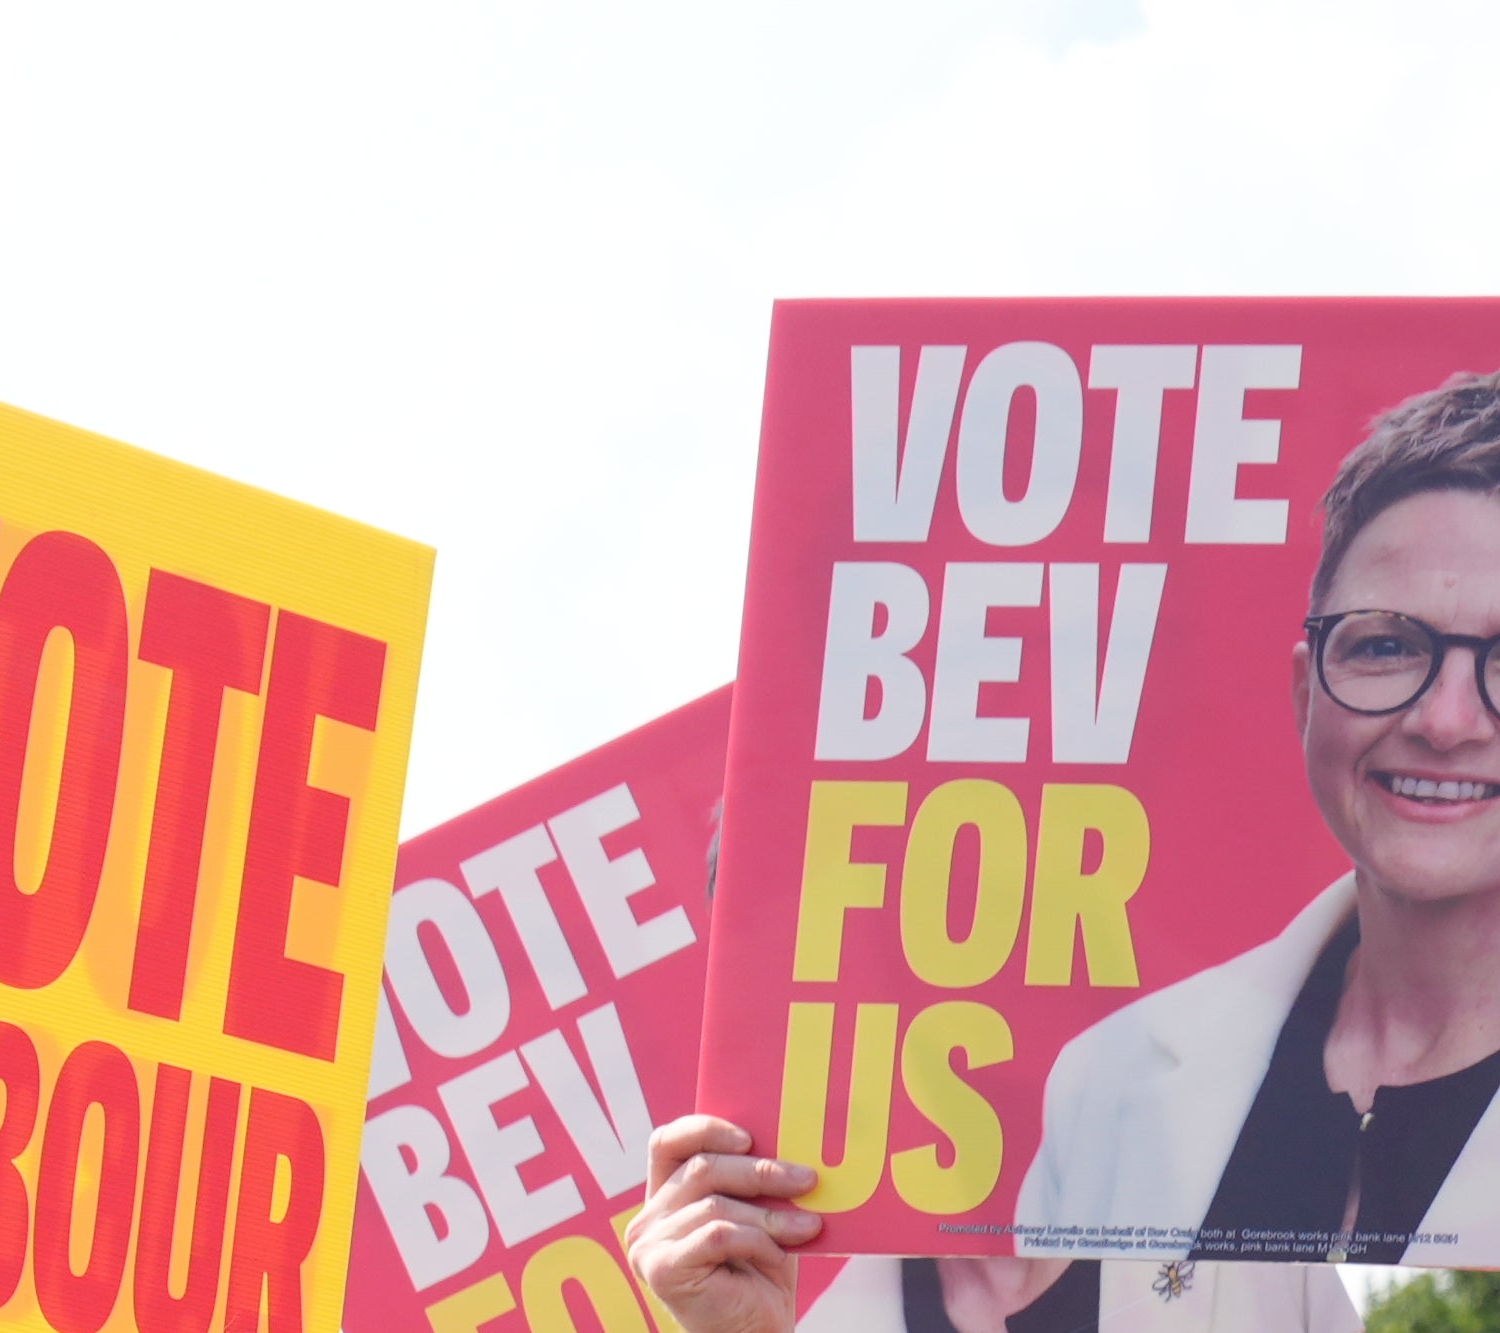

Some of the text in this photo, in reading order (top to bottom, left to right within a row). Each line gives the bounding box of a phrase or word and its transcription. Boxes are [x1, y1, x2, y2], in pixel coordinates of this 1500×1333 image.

[850, 340, 1302, 547] VOTE
[814, 561, 1169, 764] BEV
[792, 779, 1151, 989] FOR
[362, 1002, 653, 1293] BEV
[775, 1001, 1015, 1215] US
[939, 1223, 988, 1234] Promoted
[989, 1224, 1001, 1235] by
[1004, 1224, 1046, 1236] Anthony
[1086, 1228, 1099, 1236] on
[1101, 1226, 1133, 1237] behalf
[1134, 1227, 1146, 1236] of
[1200, 1228, 1223, 1238] both
[1226, 1229, 1236, 1239] at
[1241, 1229, 1295, 1240] Gorebrook
[1297, 1230, 1328, 1241] works
[1355, 1231, 1381, 1241] bank
[1383, 1232, 1405, 1242] lane
[1024, 1237, 1060, 1248] Printed
[1062, 1239, 1075, 1249] by
[1134, 1240, 1146, 1249] at
[1240, 1241, 1263, 1253] pink
[1265, 1242, 1290, 1252] bank
[1292, 1242, 1314, 1253] lane
